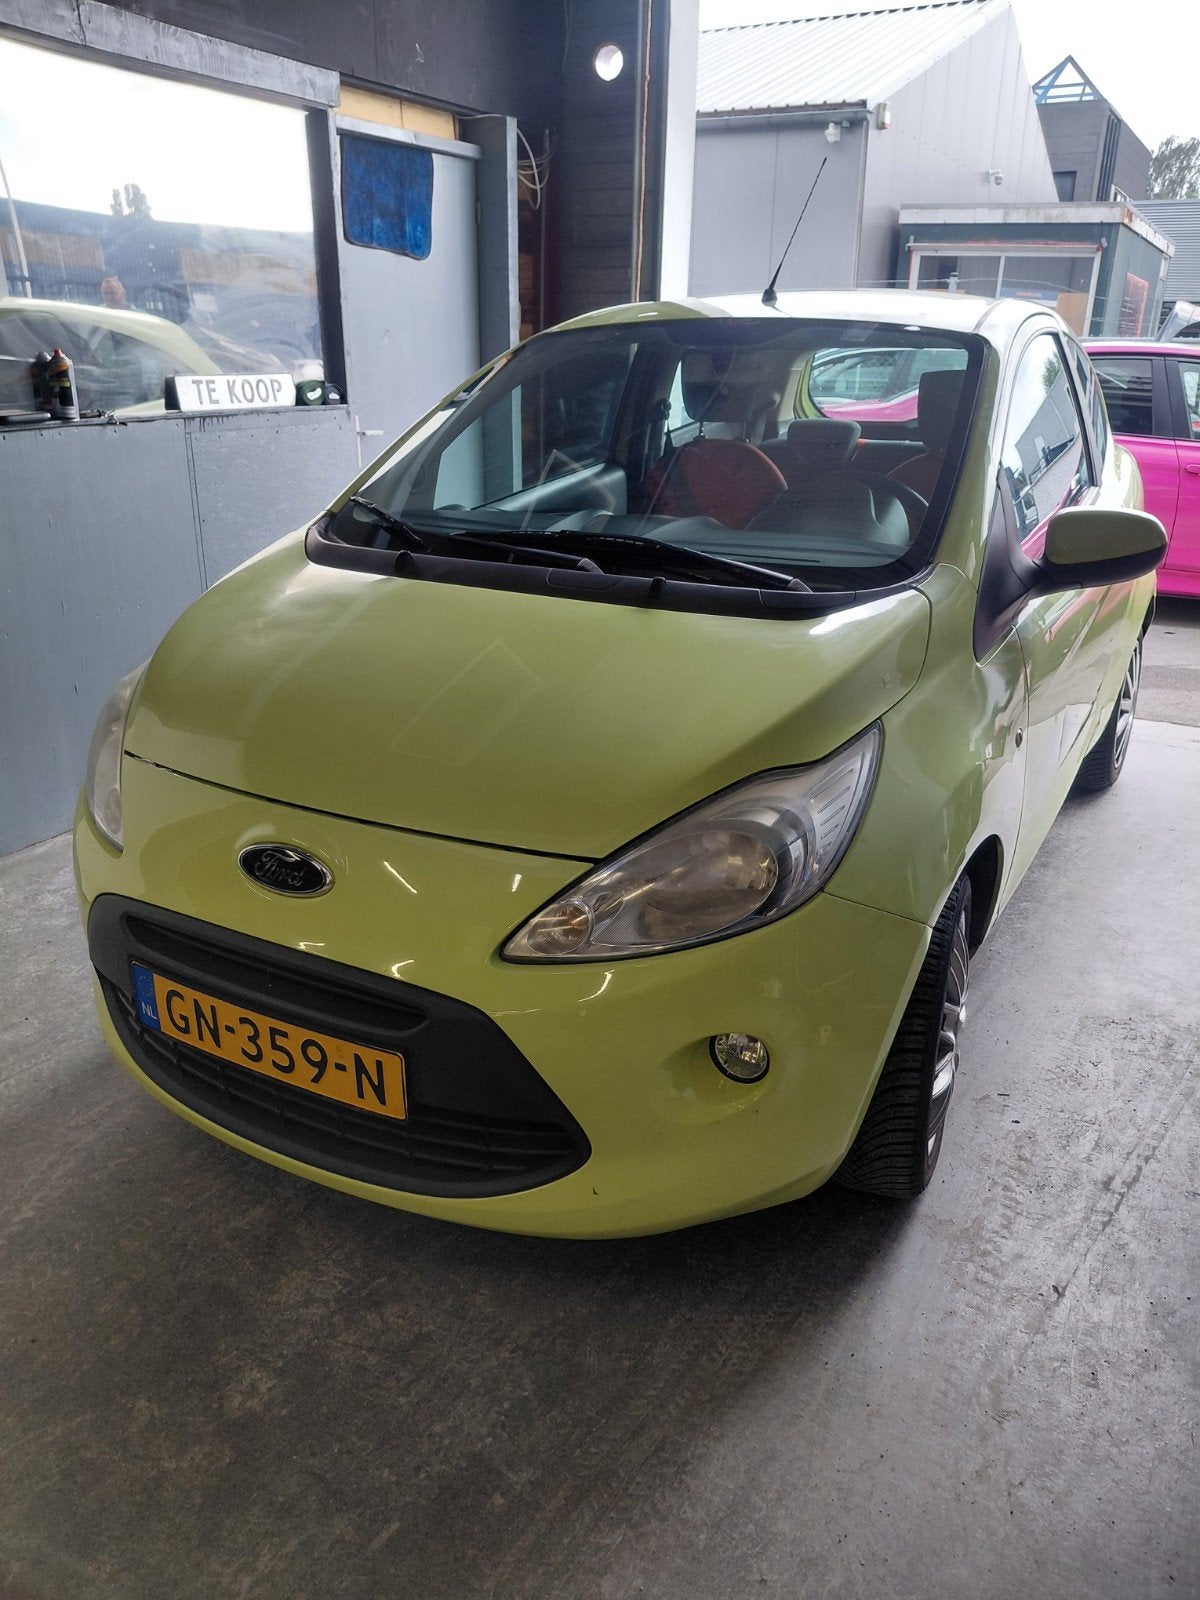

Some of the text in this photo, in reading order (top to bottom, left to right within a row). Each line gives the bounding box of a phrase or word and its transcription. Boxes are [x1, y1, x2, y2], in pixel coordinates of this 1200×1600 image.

[192, 378, 282, 405] TE KOOP
[254, 850, 306, 887] Ford
[141, 1001, 158, 1020] NL
[165, 988, 387, 1106] GN-359-N
